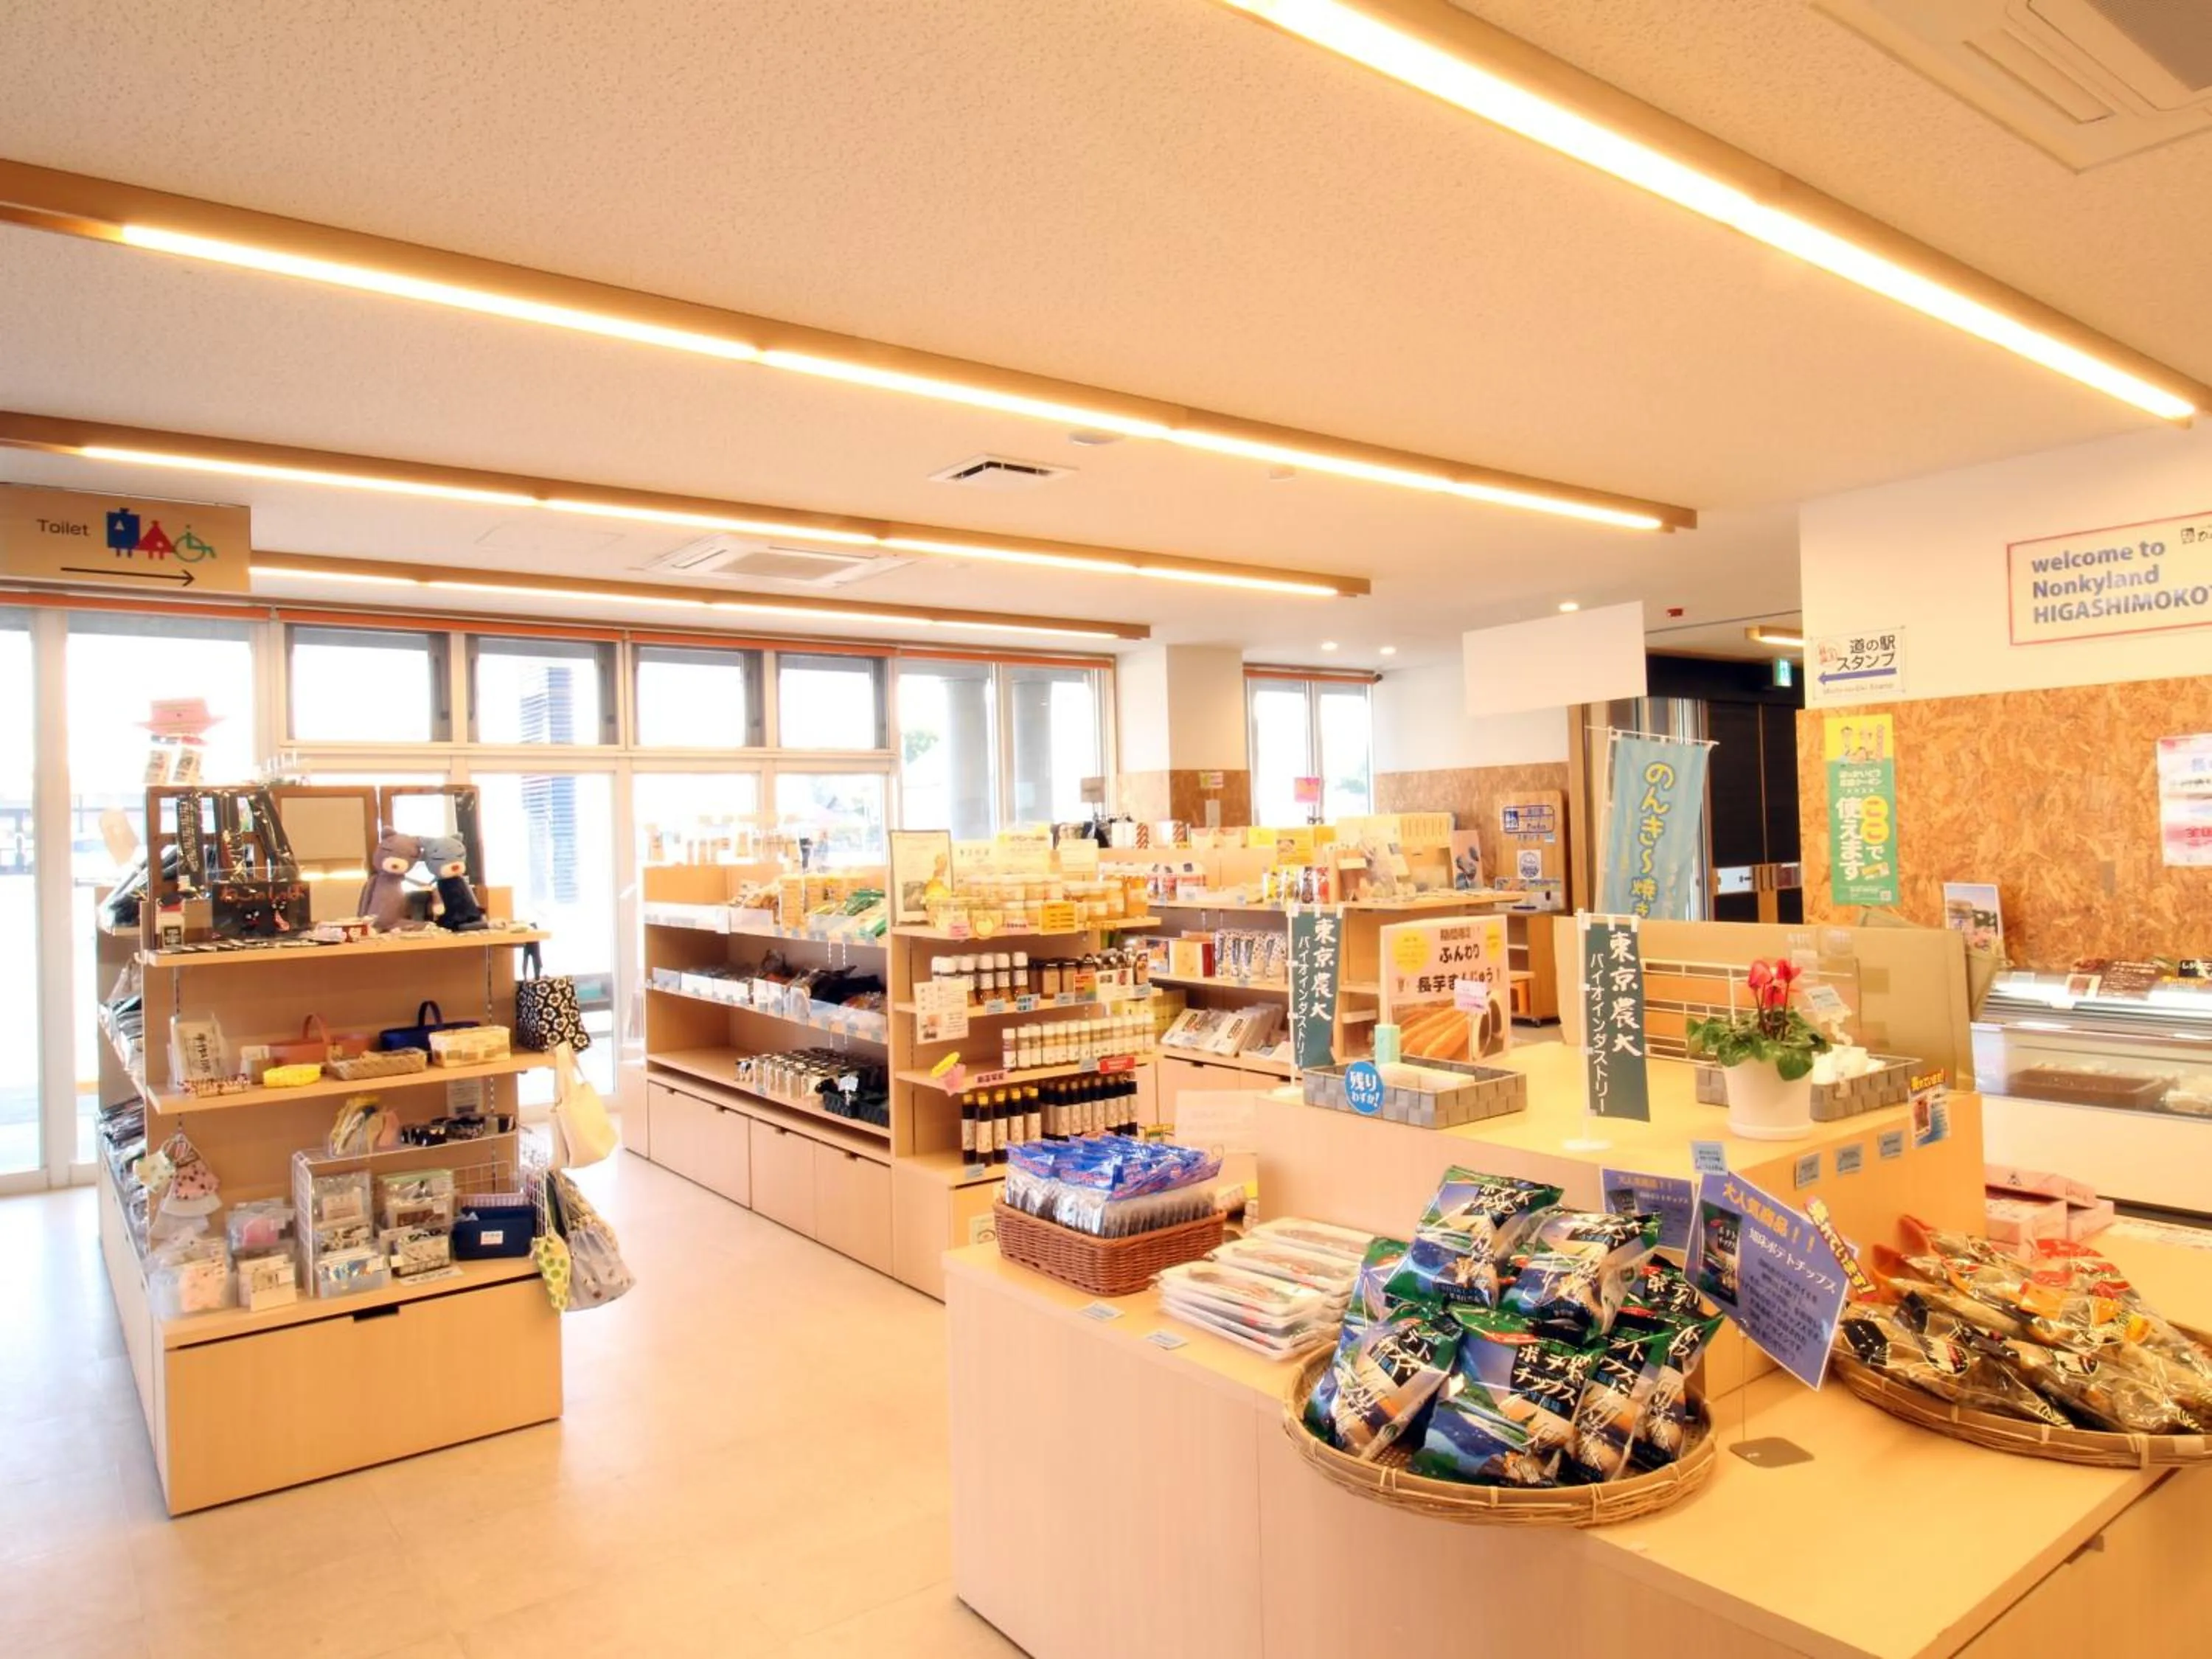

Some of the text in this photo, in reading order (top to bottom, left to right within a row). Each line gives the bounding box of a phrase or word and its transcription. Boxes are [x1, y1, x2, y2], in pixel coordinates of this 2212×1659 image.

[37, 518, 90, 537] Toilet
[2031, 540, 2166, 573] welcome to
[2033, 564, 2160, 599] Nonkyland
[2034, 583, 2212, 624] HIGASHIMOKO
[1849, 634, 1896, 654] 道の駅
[1837, 652, 1895, 672] スタンプ
[1834, 796, 1865, 881] 使えます
[1439, 944, 1481, 964] ふんわり
[1610, 931, 1643, 1057] 東京農大
[1590, 953, 1608, 1113] バイオインダストリー
